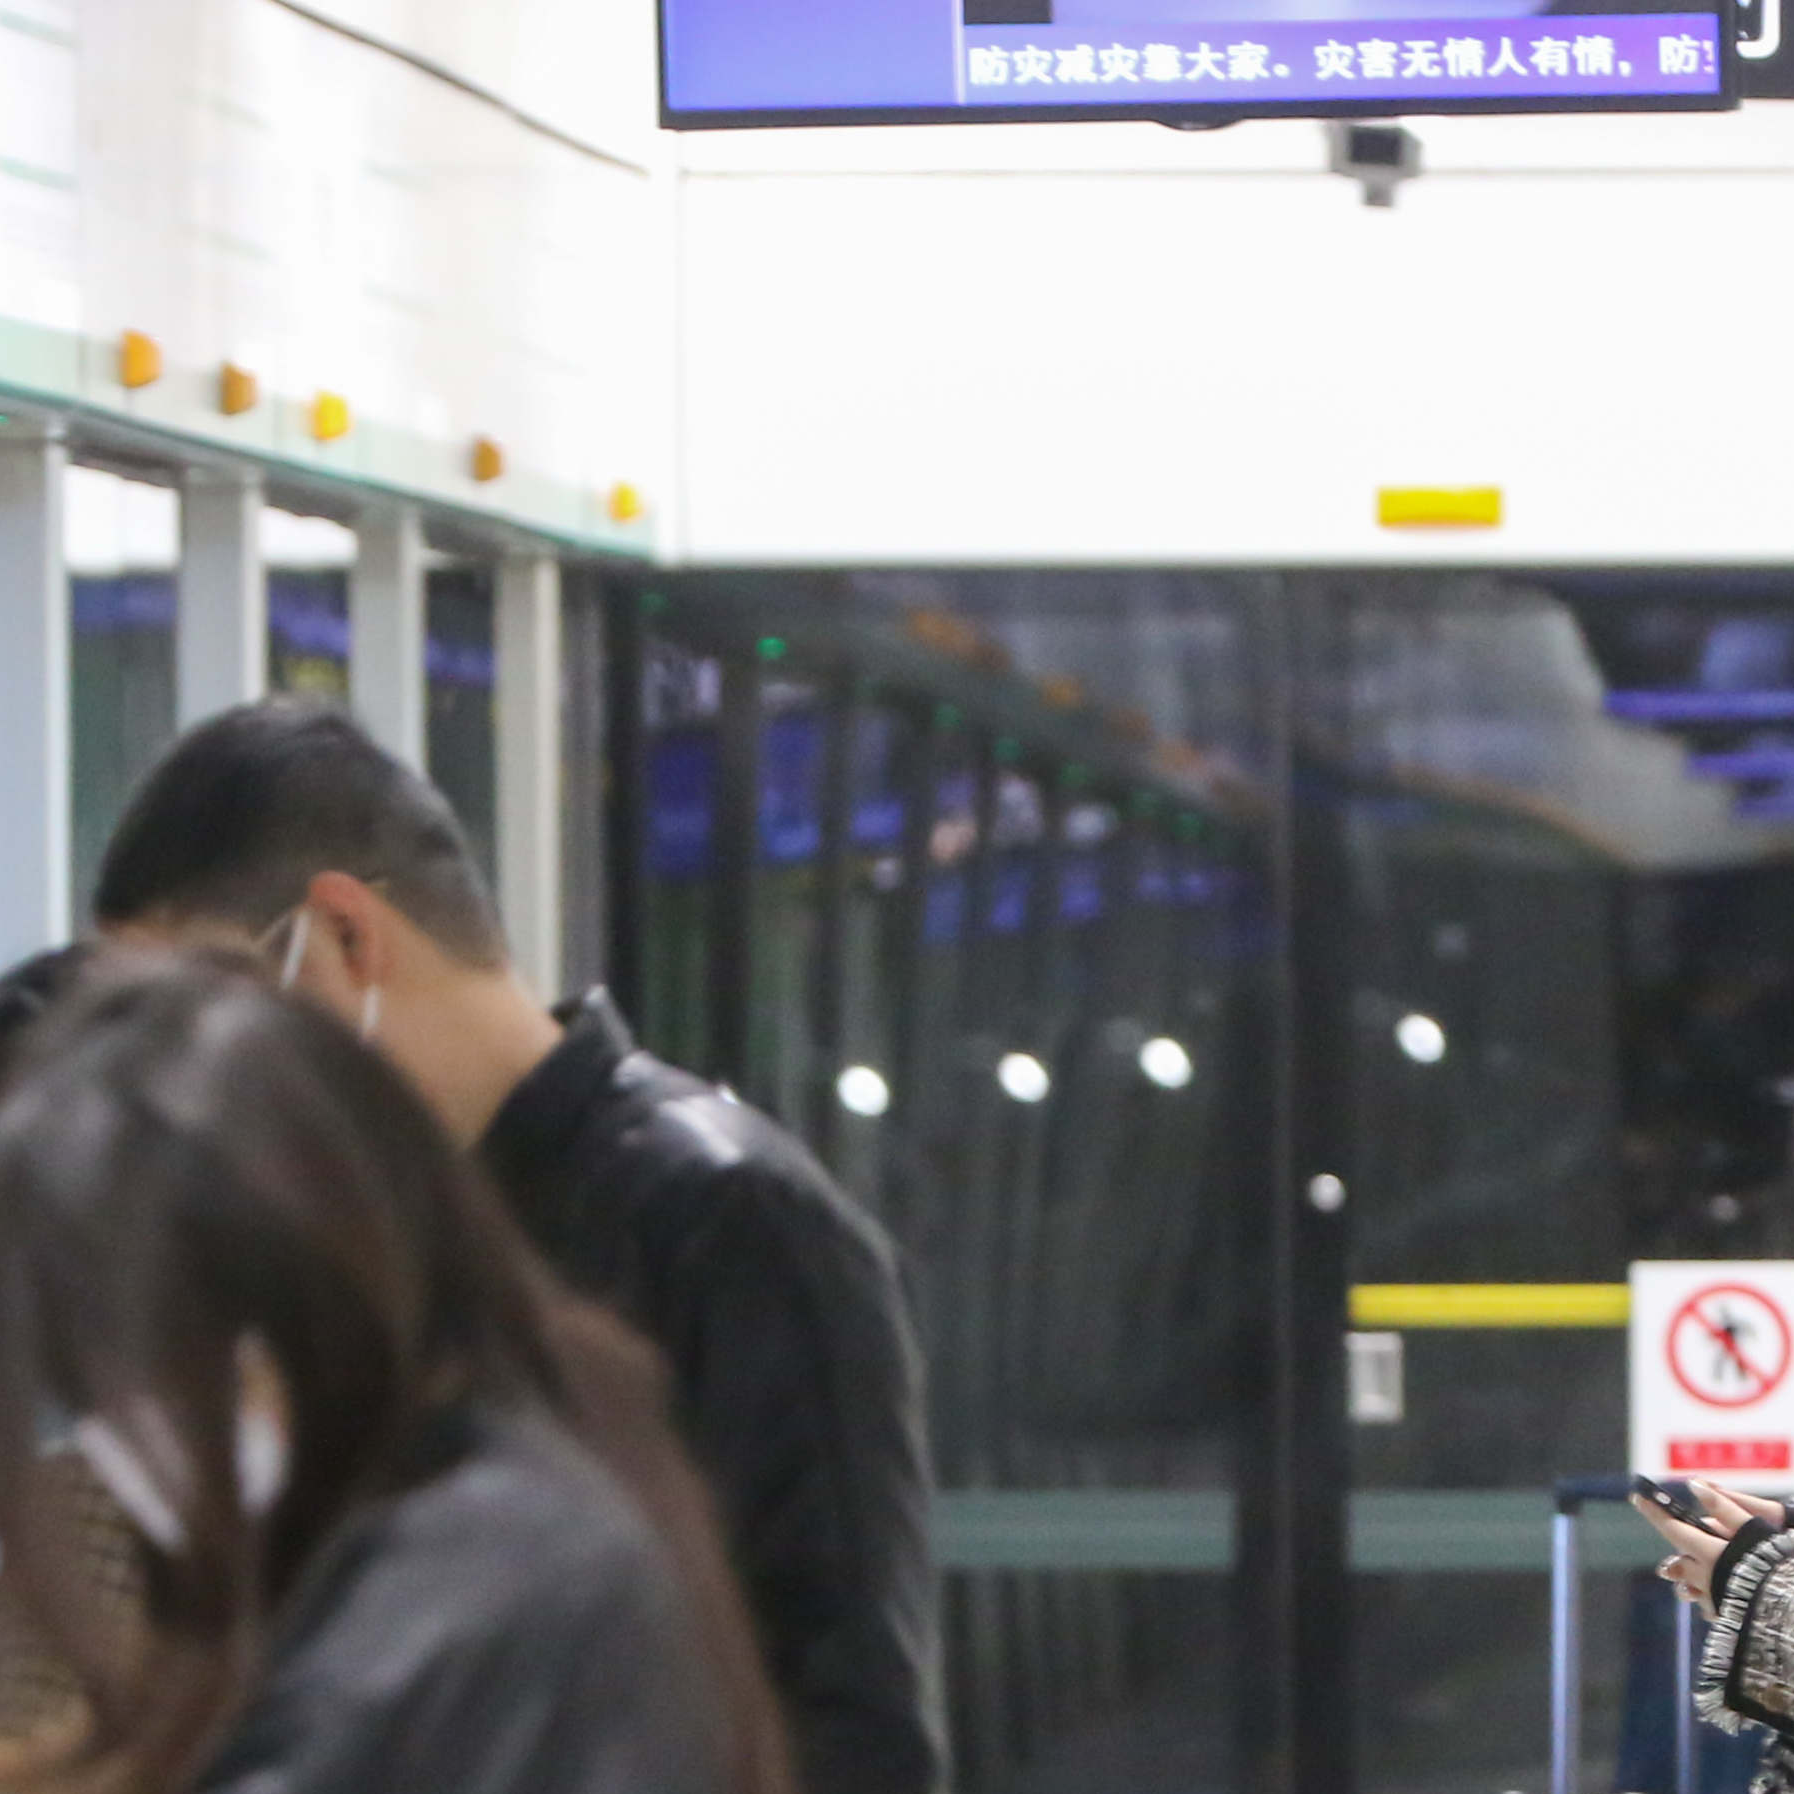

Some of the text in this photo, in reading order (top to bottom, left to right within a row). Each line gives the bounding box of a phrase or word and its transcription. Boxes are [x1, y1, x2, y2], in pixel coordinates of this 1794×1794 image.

[968, 36, 1715, 85] 防灾减灾靠大家。灾害无情人有情，防
